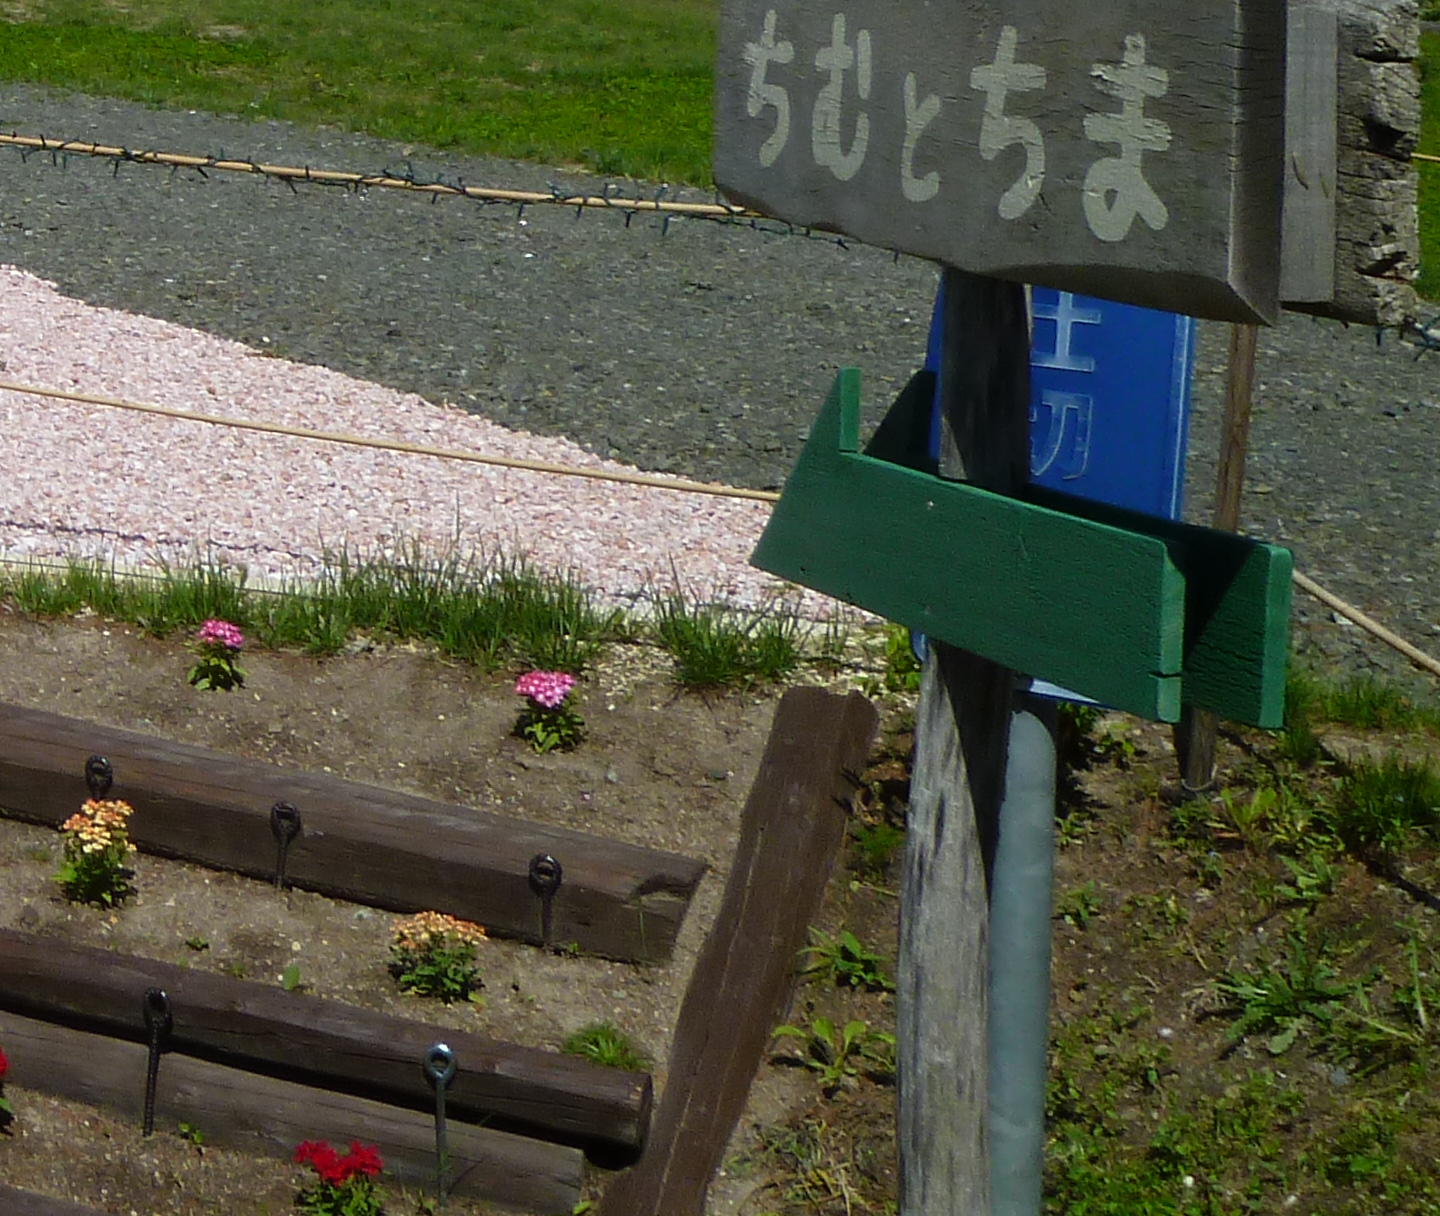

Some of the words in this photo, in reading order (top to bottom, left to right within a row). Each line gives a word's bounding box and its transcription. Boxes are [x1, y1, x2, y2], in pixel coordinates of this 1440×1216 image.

[743, 9, 1173, 243] ちむとちま
